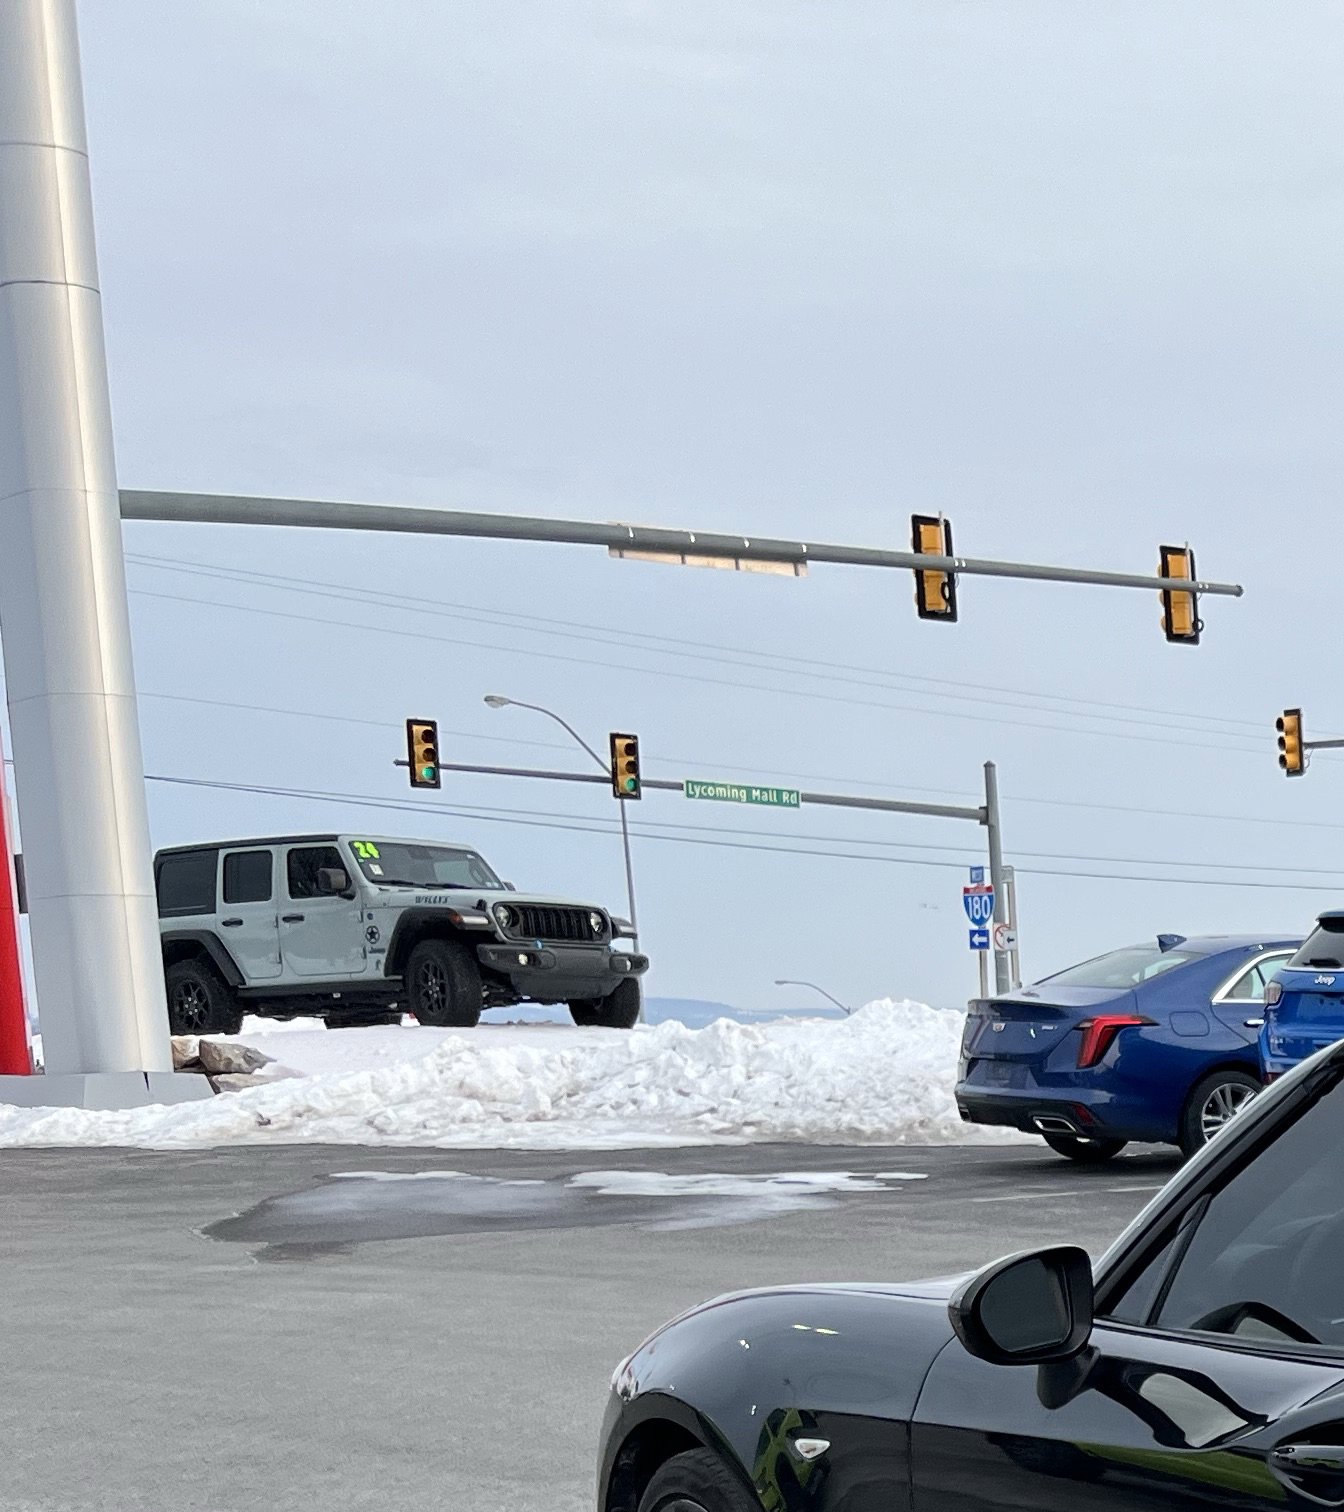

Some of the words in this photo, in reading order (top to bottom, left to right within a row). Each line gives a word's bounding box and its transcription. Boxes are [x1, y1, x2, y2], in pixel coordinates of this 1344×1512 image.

[688, 782, 747, 802] Lycoming
[752, 788, 778, 803] Mall
[782, 791, 798, 805] Rd
[353, 841, 380, 859] 24
[967, 895, 991, 920] 180
